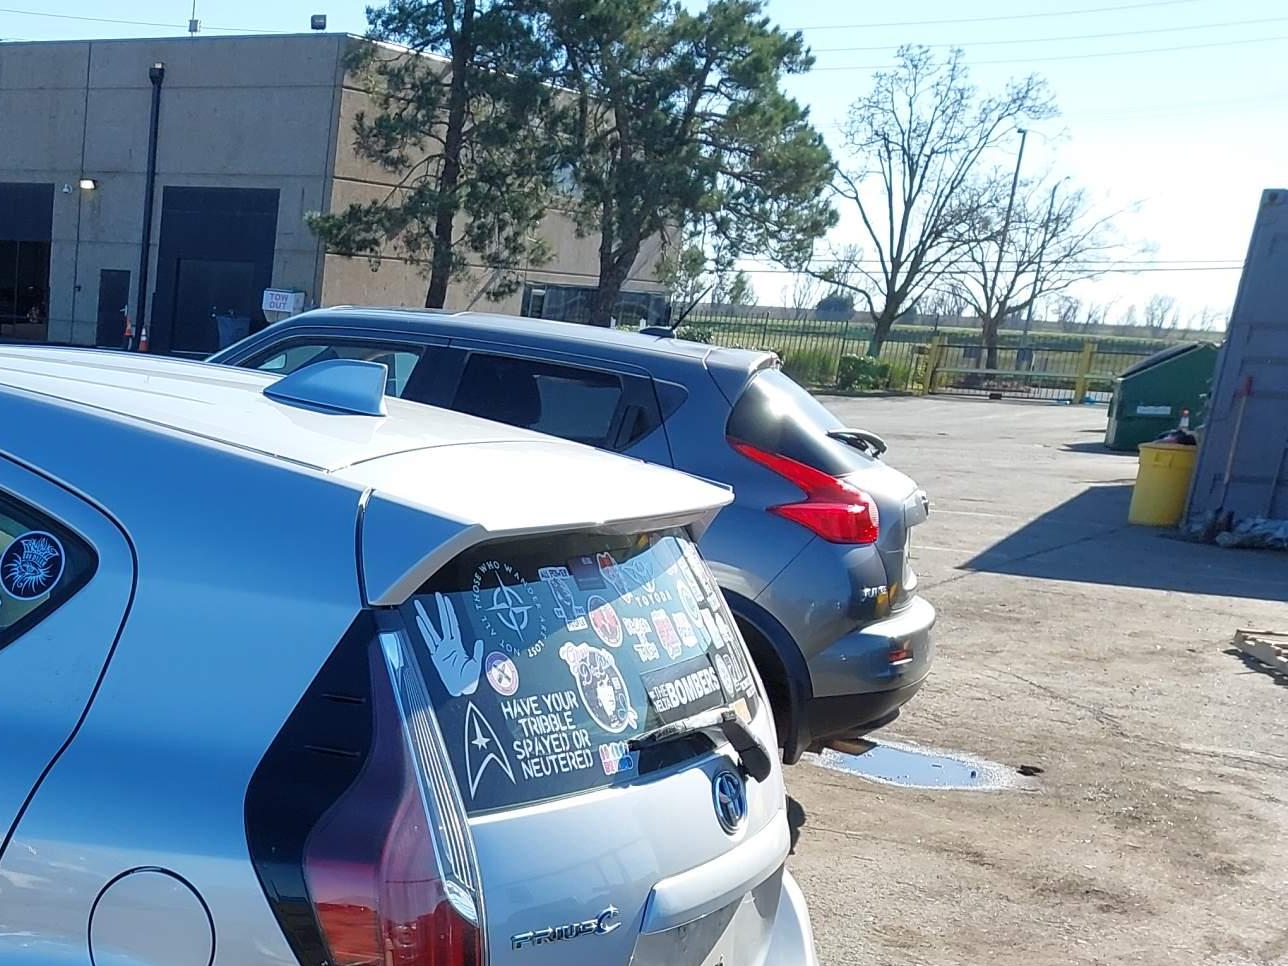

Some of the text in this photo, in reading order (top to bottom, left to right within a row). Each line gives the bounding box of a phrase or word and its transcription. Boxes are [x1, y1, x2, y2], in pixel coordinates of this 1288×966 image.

[269, 293, 289, 302] TOW
[269, 301, 287, 310] OUT
[478, 560, 500, 574] WHO
[527, 639, 545, 658] LOST
[654, 683, 670, 699] THE
[665, 666, 721, 708] BOMBERS
[500, 690, 579, 721] HAVE YOUR
[518, 711, 576, 738] TRIBBLE
[513, 732, 571, 761] SPAYED
[572, 728, 592, 750] OR
[520, 748, 594, 780] NEUTERED
[510, 918, 599, 951] PRIUS
